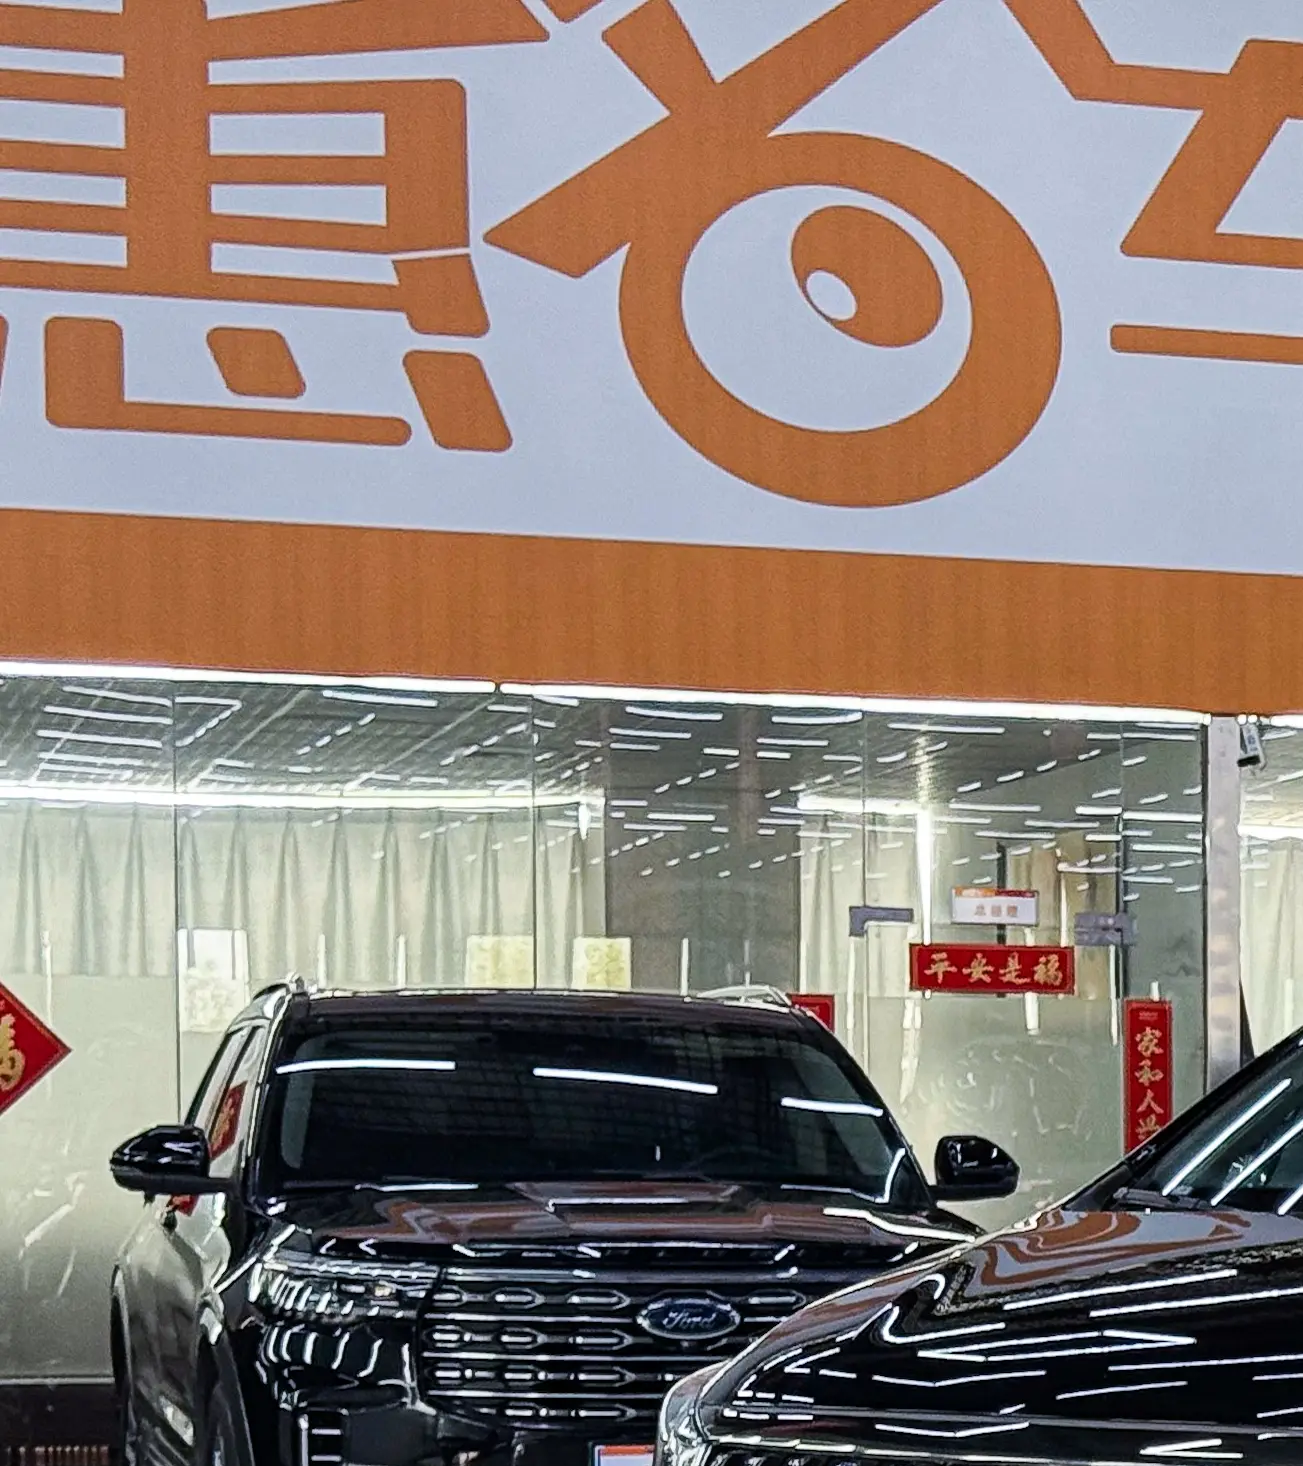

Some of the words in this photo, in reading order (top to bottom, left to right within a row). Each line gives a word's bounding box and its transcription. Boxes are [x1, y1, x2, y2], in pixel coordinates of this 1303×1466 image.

[924, 952, 1063, 986] 平安是福
[662, 1307, 717, 1330] Ford
